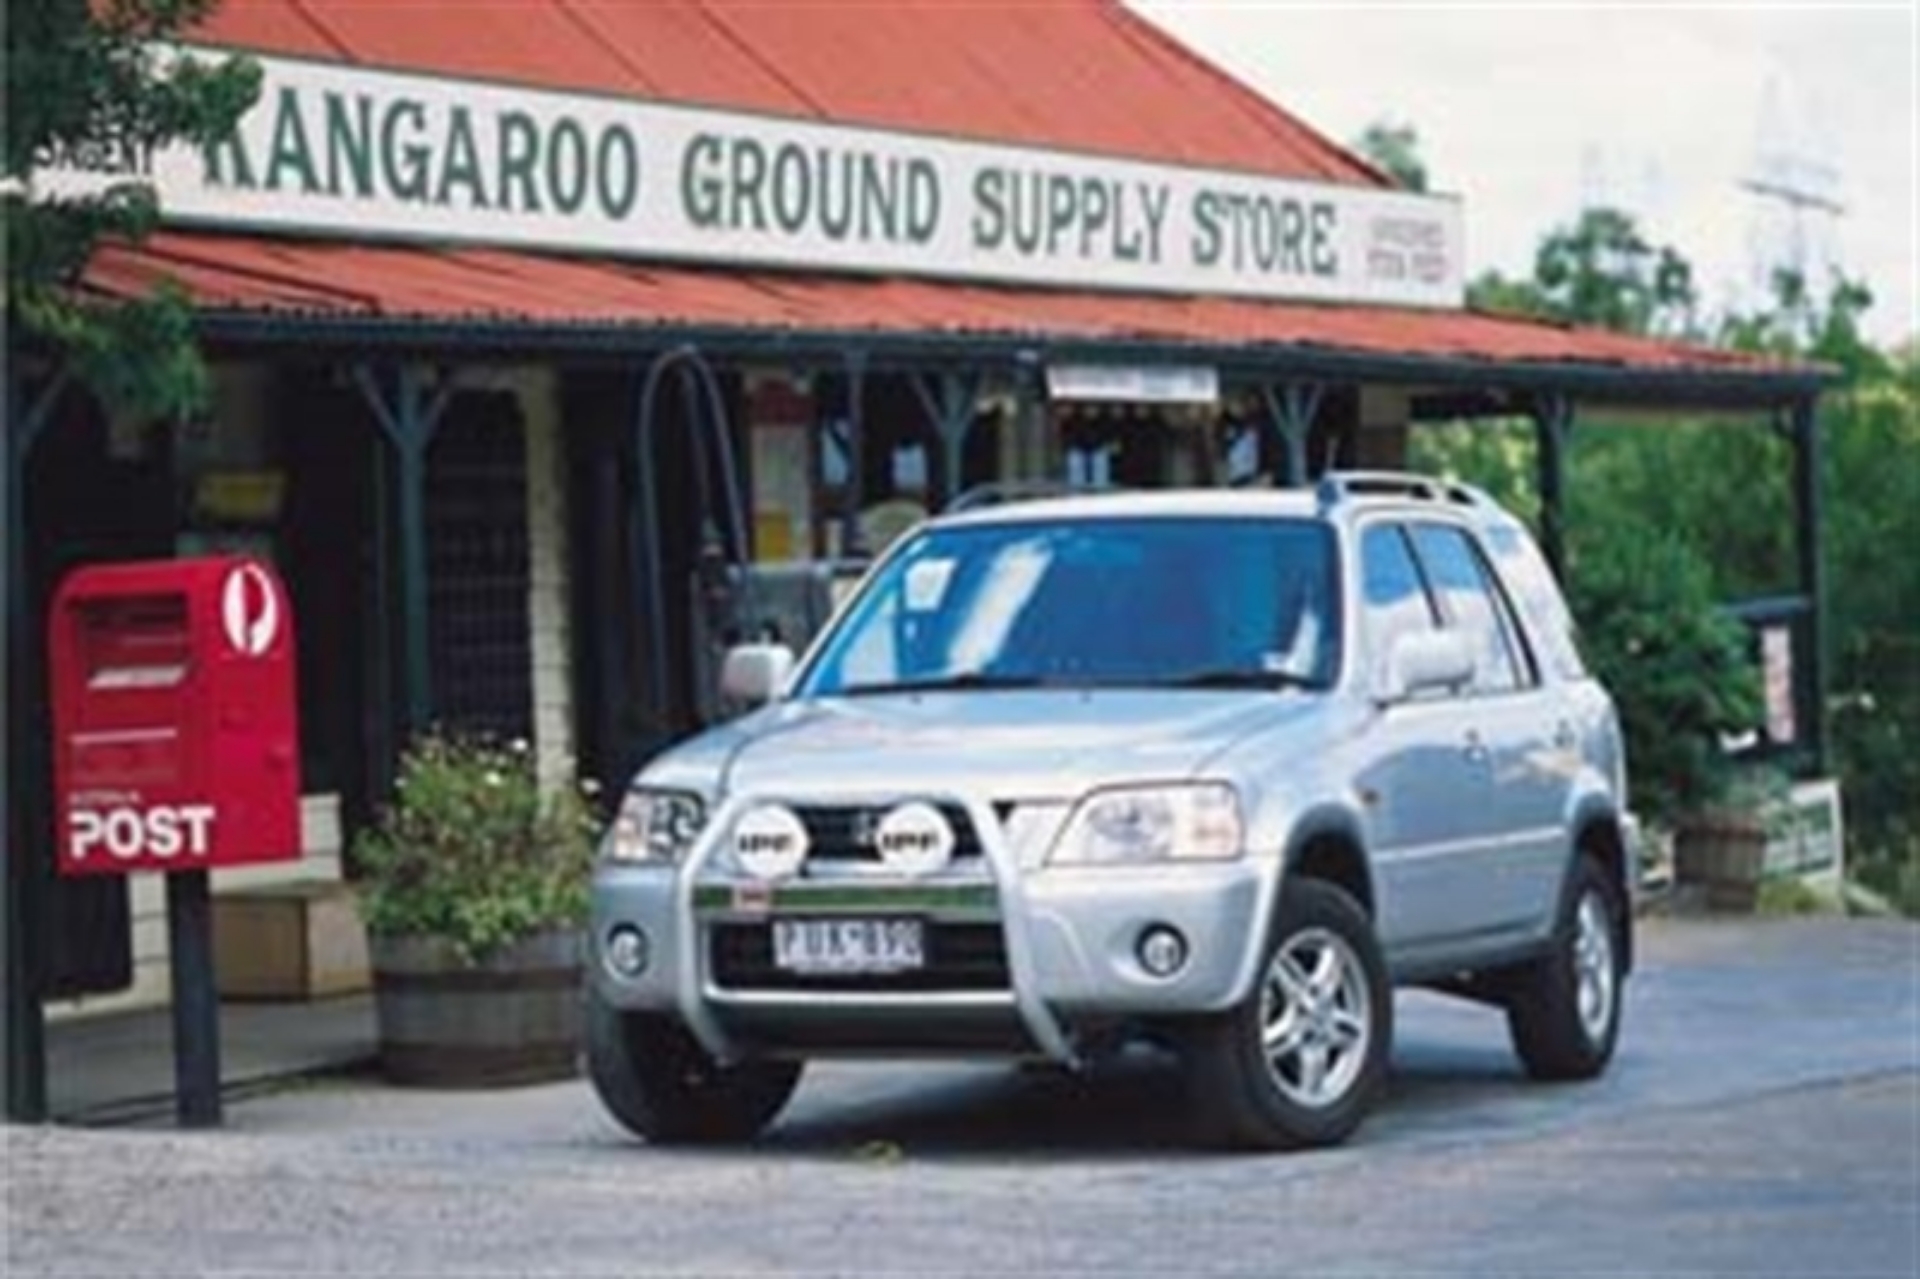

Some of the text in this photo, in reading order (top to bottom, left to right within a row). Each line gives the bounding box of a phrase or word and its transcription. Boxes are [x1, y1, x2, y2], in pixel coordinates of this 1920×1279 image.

[679, 133, 942, 240] GROUND
[971, 166, 1172, 264] SUPPLY
[1191, 191, 1338, 276] STORE
[69, 805, 217, 859] POST
